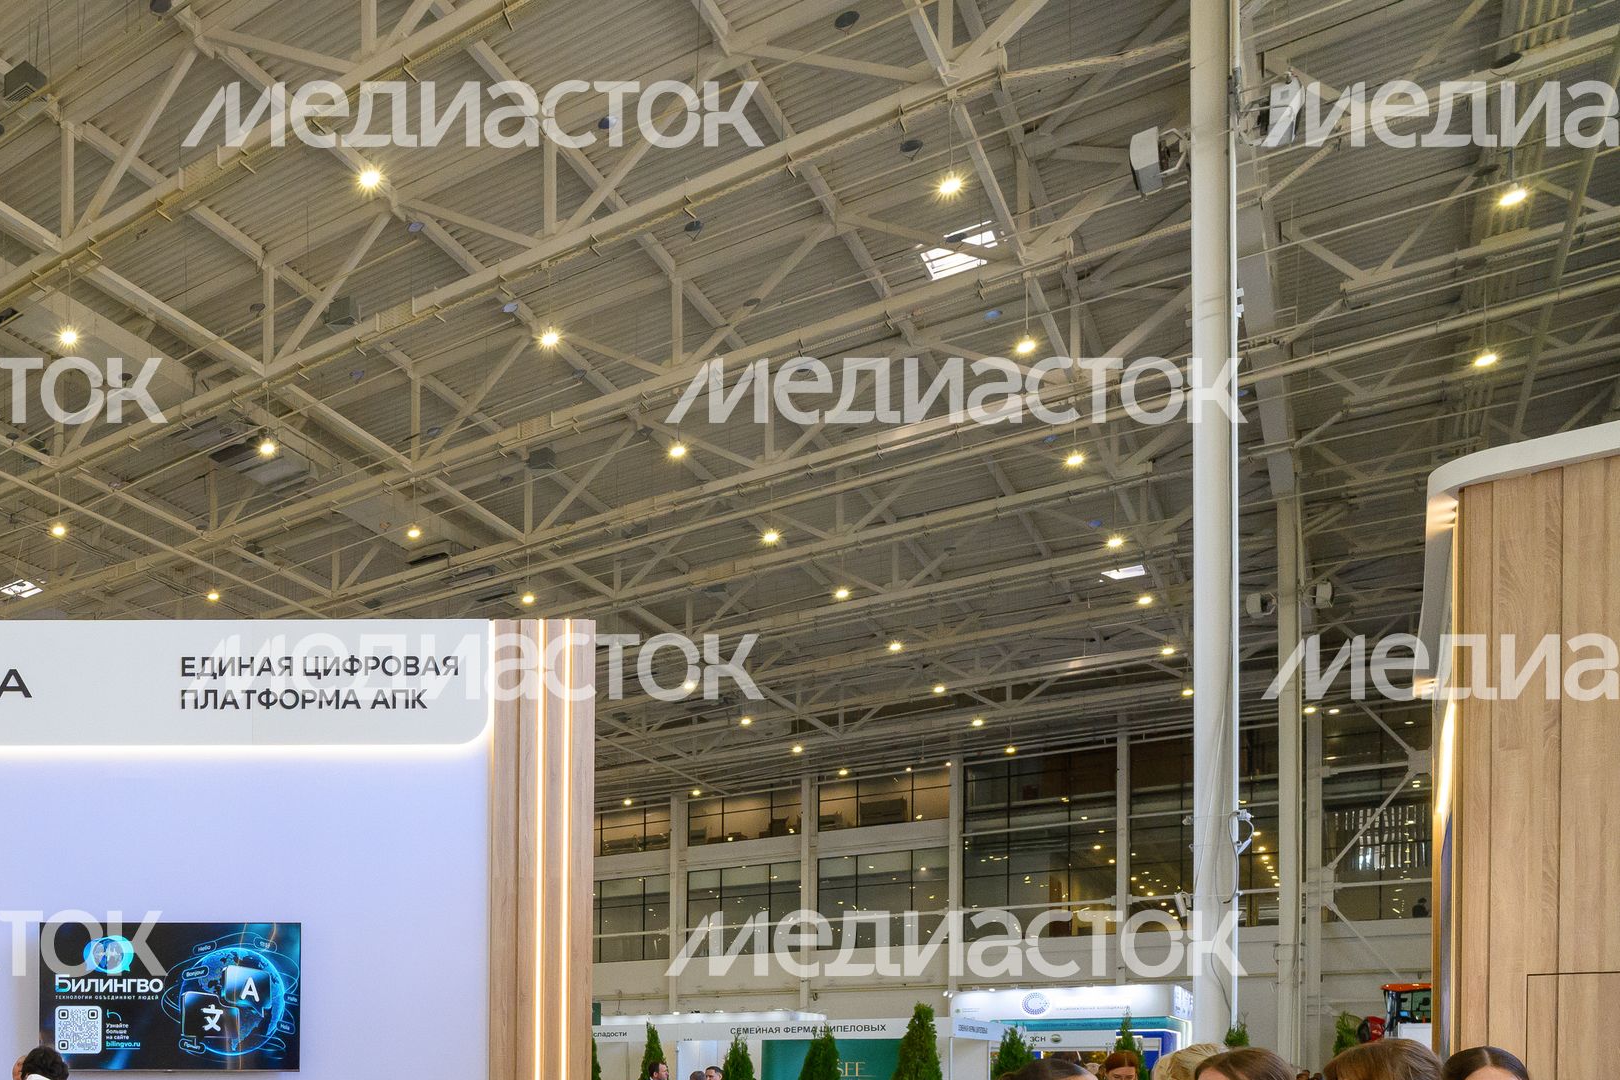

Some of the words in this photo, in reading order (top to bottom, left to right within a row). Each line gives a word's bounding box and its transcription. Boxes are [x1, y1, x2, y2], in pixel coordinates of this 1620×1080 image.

[181, 655, 293, 680] ЕДИНАЯ
[303, 654, 460, 680] ЦИФРОВАЯ
[181, 688, 362, 710] ПЛАТФОРМА
[370, 688, 428, 710] АПК
[105, 1022, 129, 1030] Узнайте
[201, 1004, 224, 1032] 文
[730, 1025, 780, 1035] СЕМЕЙНАЯ
[783, 1025, 817, 1034] ФЕРМА
[820, 1023, 887, 1034] ШИПЕЛОВЫХ
[105, 1040, 141, 1048] bilingvo.ru
